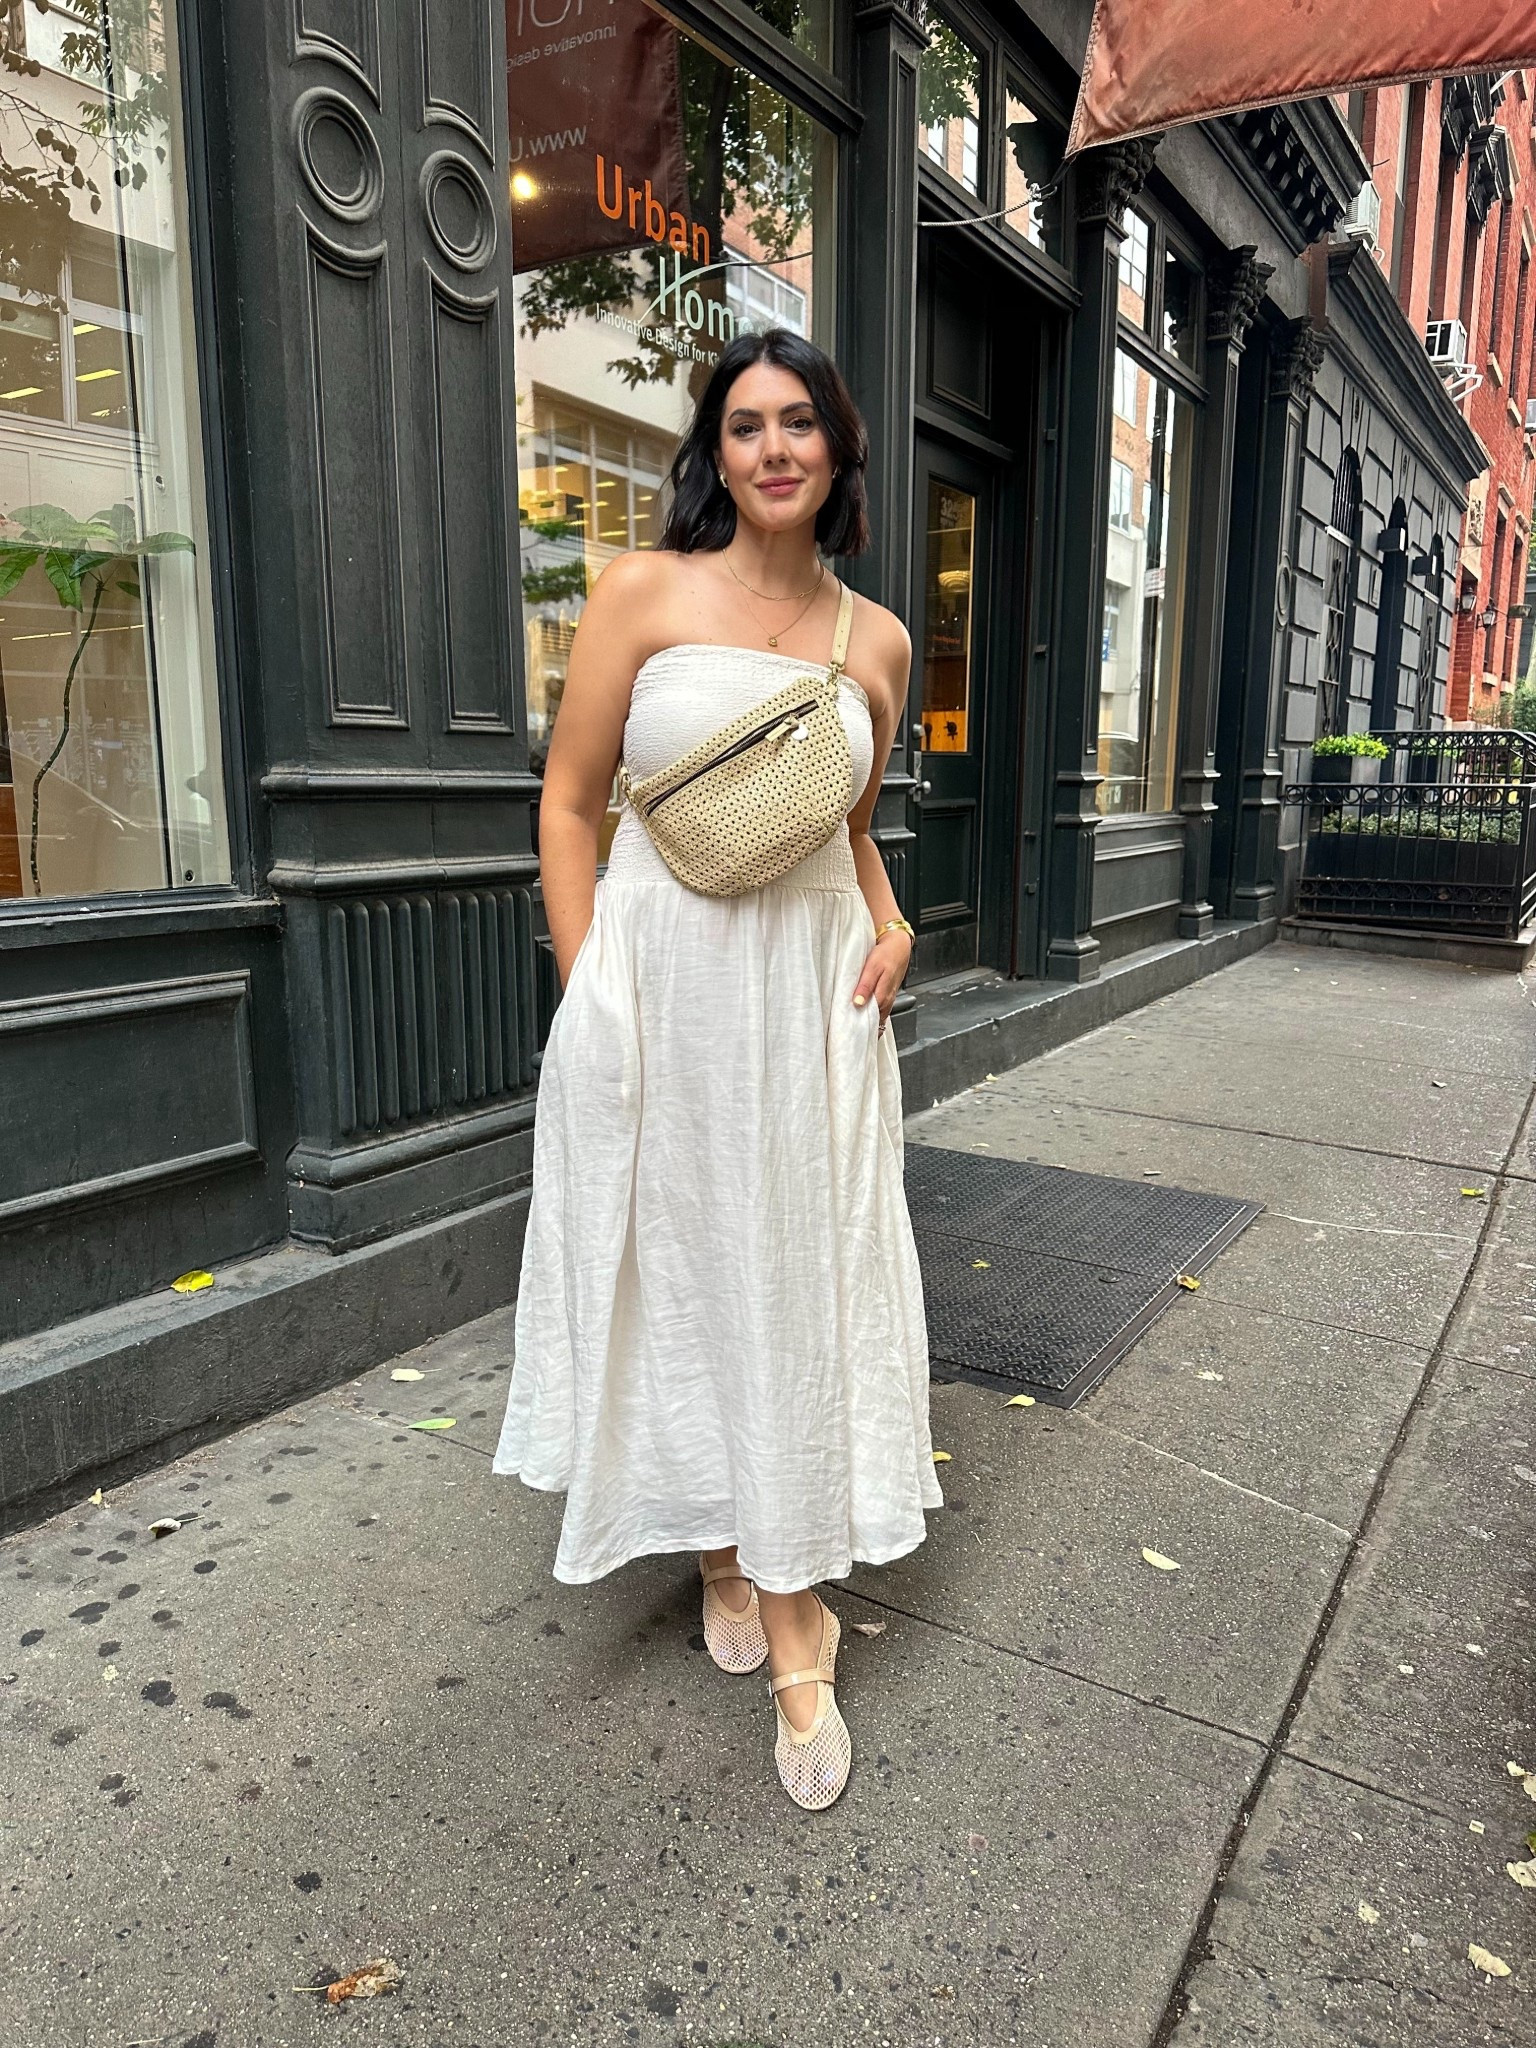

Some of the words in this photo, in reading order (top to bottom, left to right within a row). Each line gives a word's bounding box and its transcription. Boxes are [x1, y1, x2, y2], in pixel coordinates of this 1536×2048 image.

[596, 154, 710, 266] Urban
[596, 302, 654, 342] Innovative
[655, 328, 690, 358] Design
[691, 342, 706, 363] for
